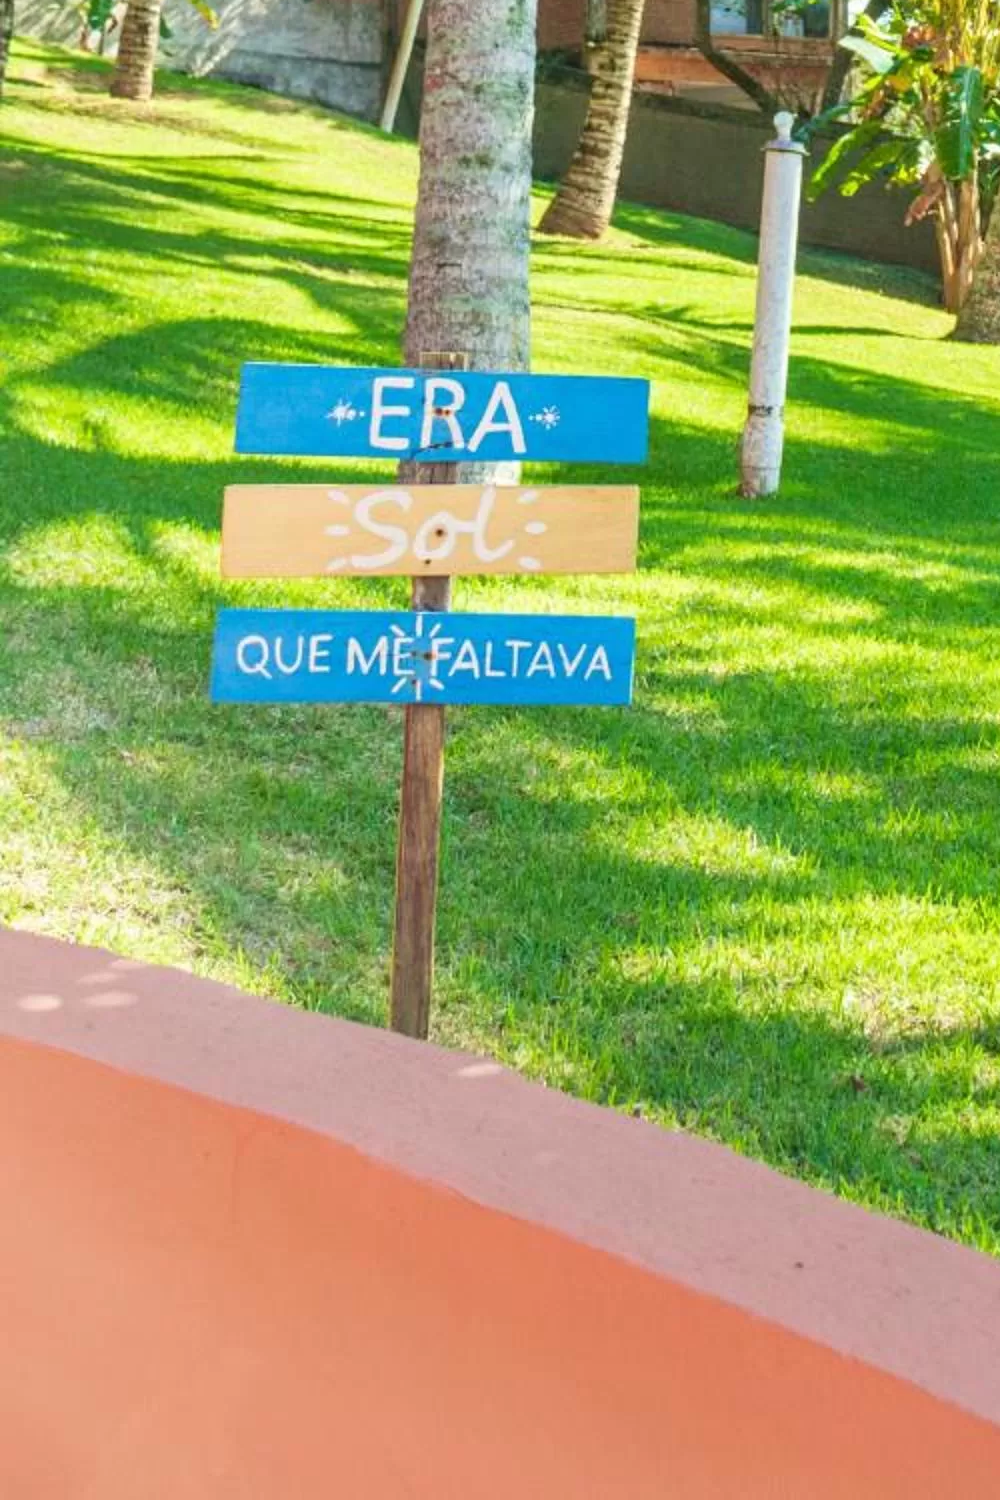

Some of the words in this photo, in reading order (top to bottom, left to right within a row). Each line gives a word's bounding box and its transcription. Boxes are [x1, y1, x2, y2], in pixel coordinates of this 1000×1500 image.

[368, 376, 527, 453] ERA
[348, 485, 515, 568] Sol
[236, 634, 334, 680] QUE
[346, 635, 415, 677] ME
[430, 636, 612, 681] FALTAVA
